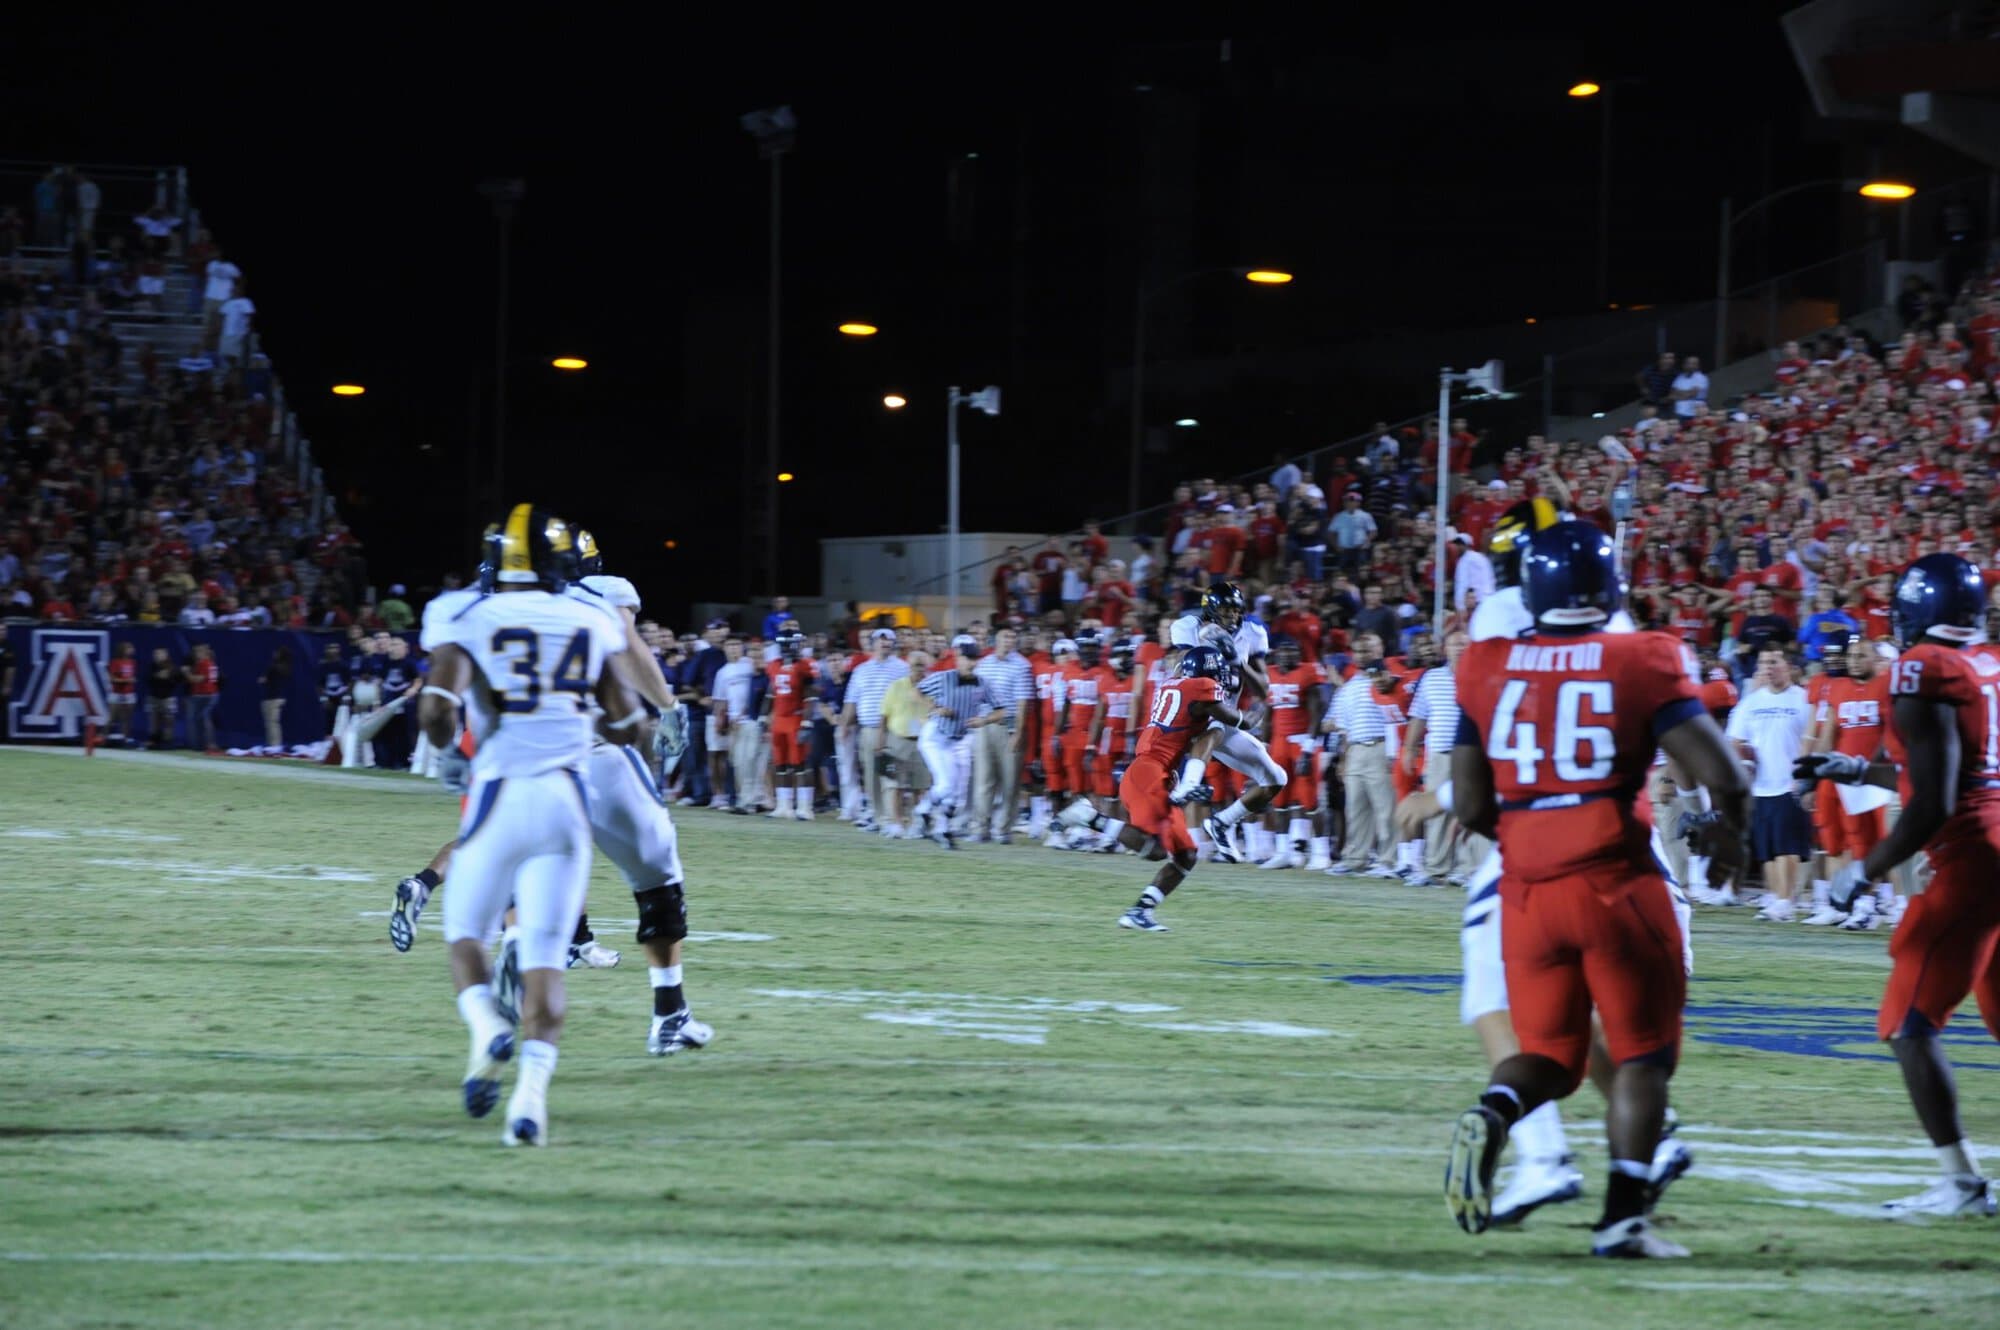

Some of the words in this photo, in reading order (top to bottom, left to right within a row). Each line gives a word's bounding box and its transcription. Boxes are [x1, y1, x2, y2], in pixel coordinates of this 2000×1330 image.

[490, 626, 592, 714] 34
[775, 674, 792, 694] 5
[1889, 660, 1923, 695] 15
[1486, 678, 1616, 785] 46
